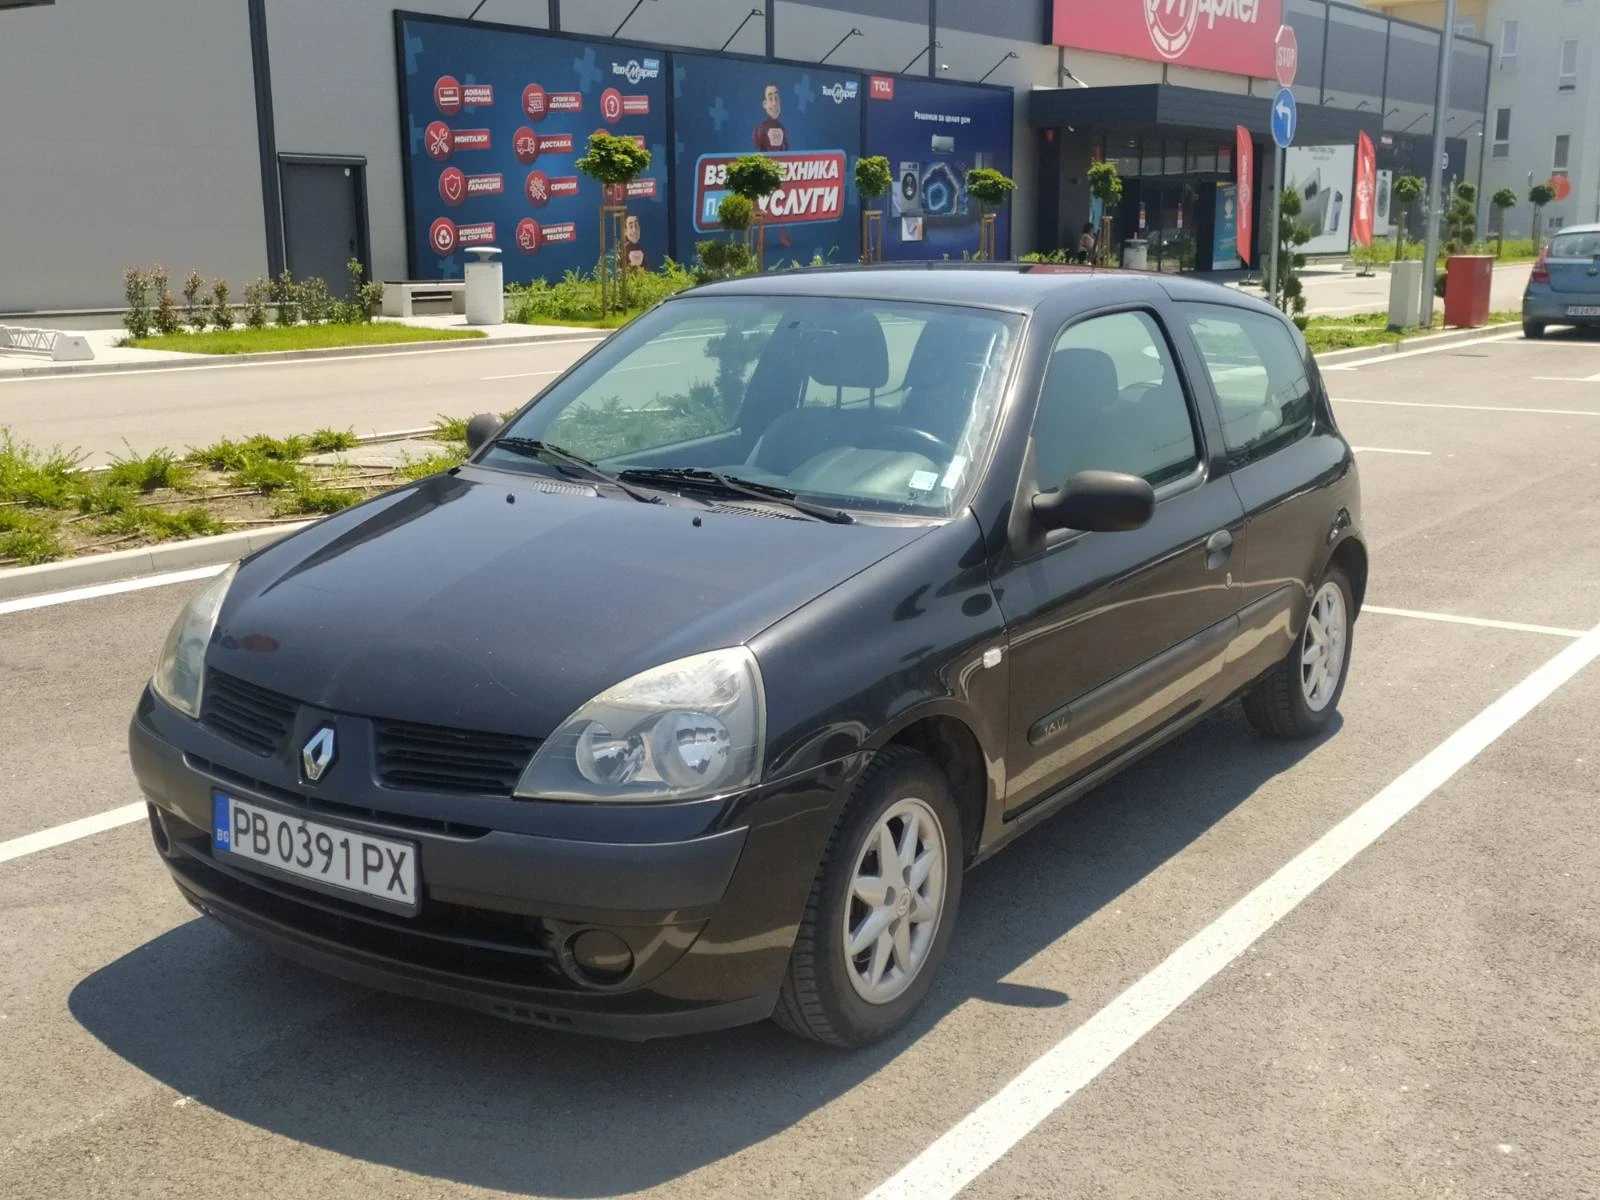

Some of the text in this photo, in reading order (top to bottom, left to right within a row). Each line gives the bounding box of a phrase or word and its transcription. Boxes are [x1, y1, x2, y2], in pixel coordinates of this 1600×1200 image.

[1278, 46, 1295, 67] STOP
[873, 80, 891, 93] TCL
[454, 135, 488, 144] МОНТАЖИ
[540, 140, 572, 149] ДОСТАВКА
[778, 160, 839, 182] ЕХНИКА
[216, 828, 230, 843] BG
[233, 806, 408, 895] PB 0391 PX
